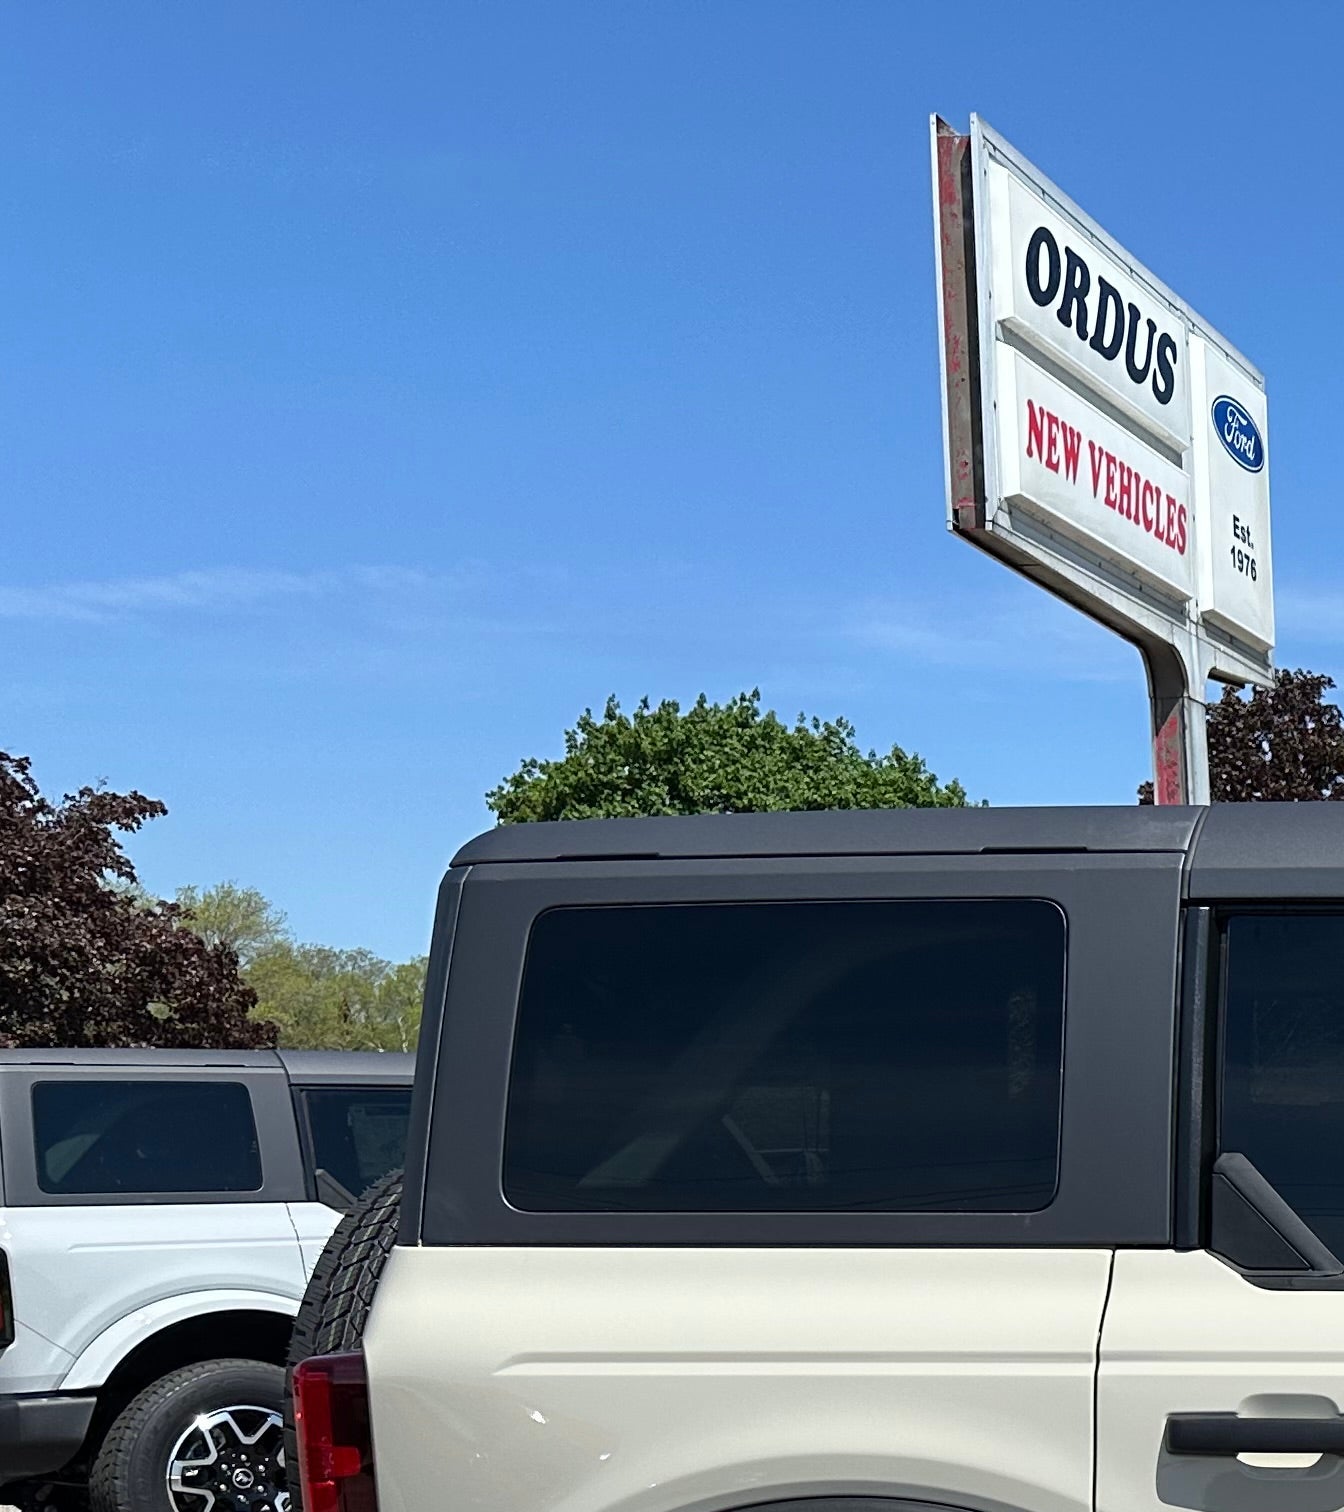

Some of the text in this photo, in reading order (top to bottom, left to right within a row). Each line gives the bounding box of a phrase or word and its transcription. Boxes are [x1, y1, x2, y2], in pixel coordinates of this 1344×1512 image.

[1025, 226, 1178, 405] ORDUS
[1025, 398, 1188, 556] NEW VEHICLES
[1230, 545, 1257, 582] 1976
[1232, 514, 1254, 550] Est.
